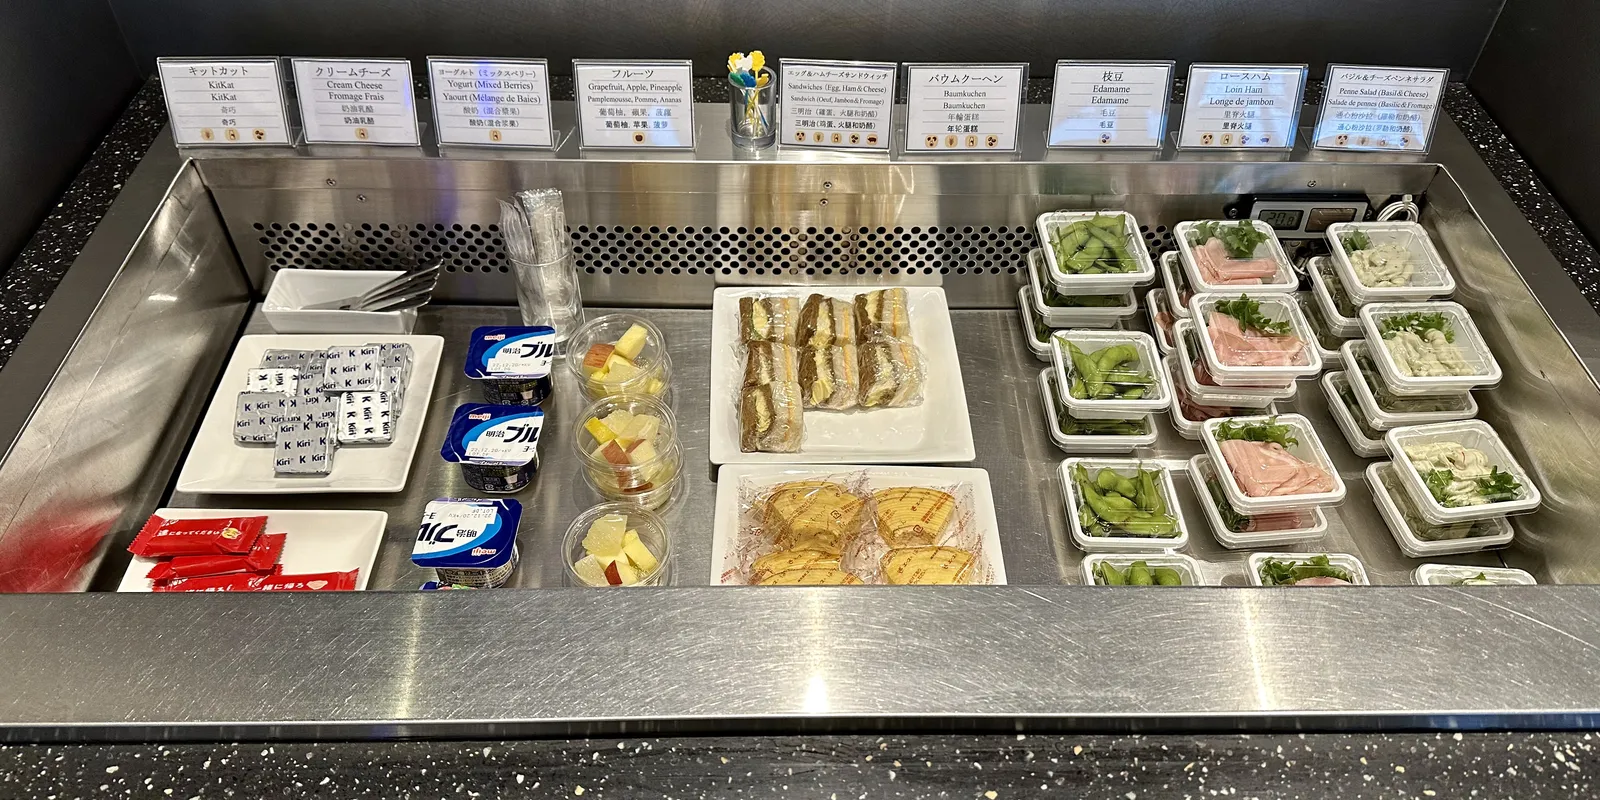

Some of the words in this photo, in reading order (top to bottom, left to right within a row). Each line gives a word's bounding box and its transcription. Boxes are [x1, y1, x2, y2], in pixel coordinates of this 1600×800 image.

[188, 66, 249, 76] キットカット
[315, 67, 391, 77] クリームチーズ
[612, 69, 654, 79] フルーツ
[928, 74, 1004, 84] バウムクーヘン
[1102, 71, 1124, 82] 枝豆
[1220, 72, 1271, 81] ロースハム
[208, 81, 235, 89] KitKat
[327, 81, 353, 89] Cream
[355, 81, 383, 90] Cheese
[447, 80, 476, 90] Yogurt
[475, 80, 502, 89] (Mixed
[503, 81, 534, 90] Berries)
[588, 83, 625, 91] Grapefruit,
[626, 83, 648, 92] Apple,
[650, 84, 683, 92] Pineapple
[788, 83, 822, 91] Sandwiches
[1093, 85, 1131, 93] Edamame
[1244, 86, 1263, 94] Ham
[1359, 88, 1377, 96] Salad
[211, 93, 237, 101] KitKat
[328, 92, 363, 102] Fromage
[364, 93, 385, 101] Frais
[443, 93, 468, 101] Yaourt
[469, 93, 505, 104] (Mélange
[506, 94, 516, 102] de
[517, 95, 541, 103] Baies)
[587, 96, 633, 104] Pamplemousse,
[1091, 96, 1129, 104] Edamame
[1209, 98, 1234, 107] Longe
[1235, 98, 1245, 106] de
[1245, 98, 1274, 107] jambon
[221, 106, 236, 114] 奇巧
[1101, 109, 1116, 117] 毛豆
[1099, 121, 1114, 129] 毛豆
[342, 365, 356, 373] Kiri
[345, 379, 352, 387] K
[256, 401, 270, 409] Kiri
[279, 399, 285, 407] K
[290, 399, 297, 407] K
[236, 420, 250, 428] Kiri
[259, 417, 266, 425] K
[280, 425, 294, 433] Kiri
[303, 422, 310, 430] K
[503, 423, 540, 443] ブル
[284, 441, 291, 450] K
[296, 439, 311, 447] Kiri
[319, 437, 326, 445] K
[276, 458, 290, 466] Kiri
[299, 455, 306, 463] K
[311, 453, 326, 461] Kiri
[456, 529, 478, 538] 明治
[472, 547, 497, 556] meiji
